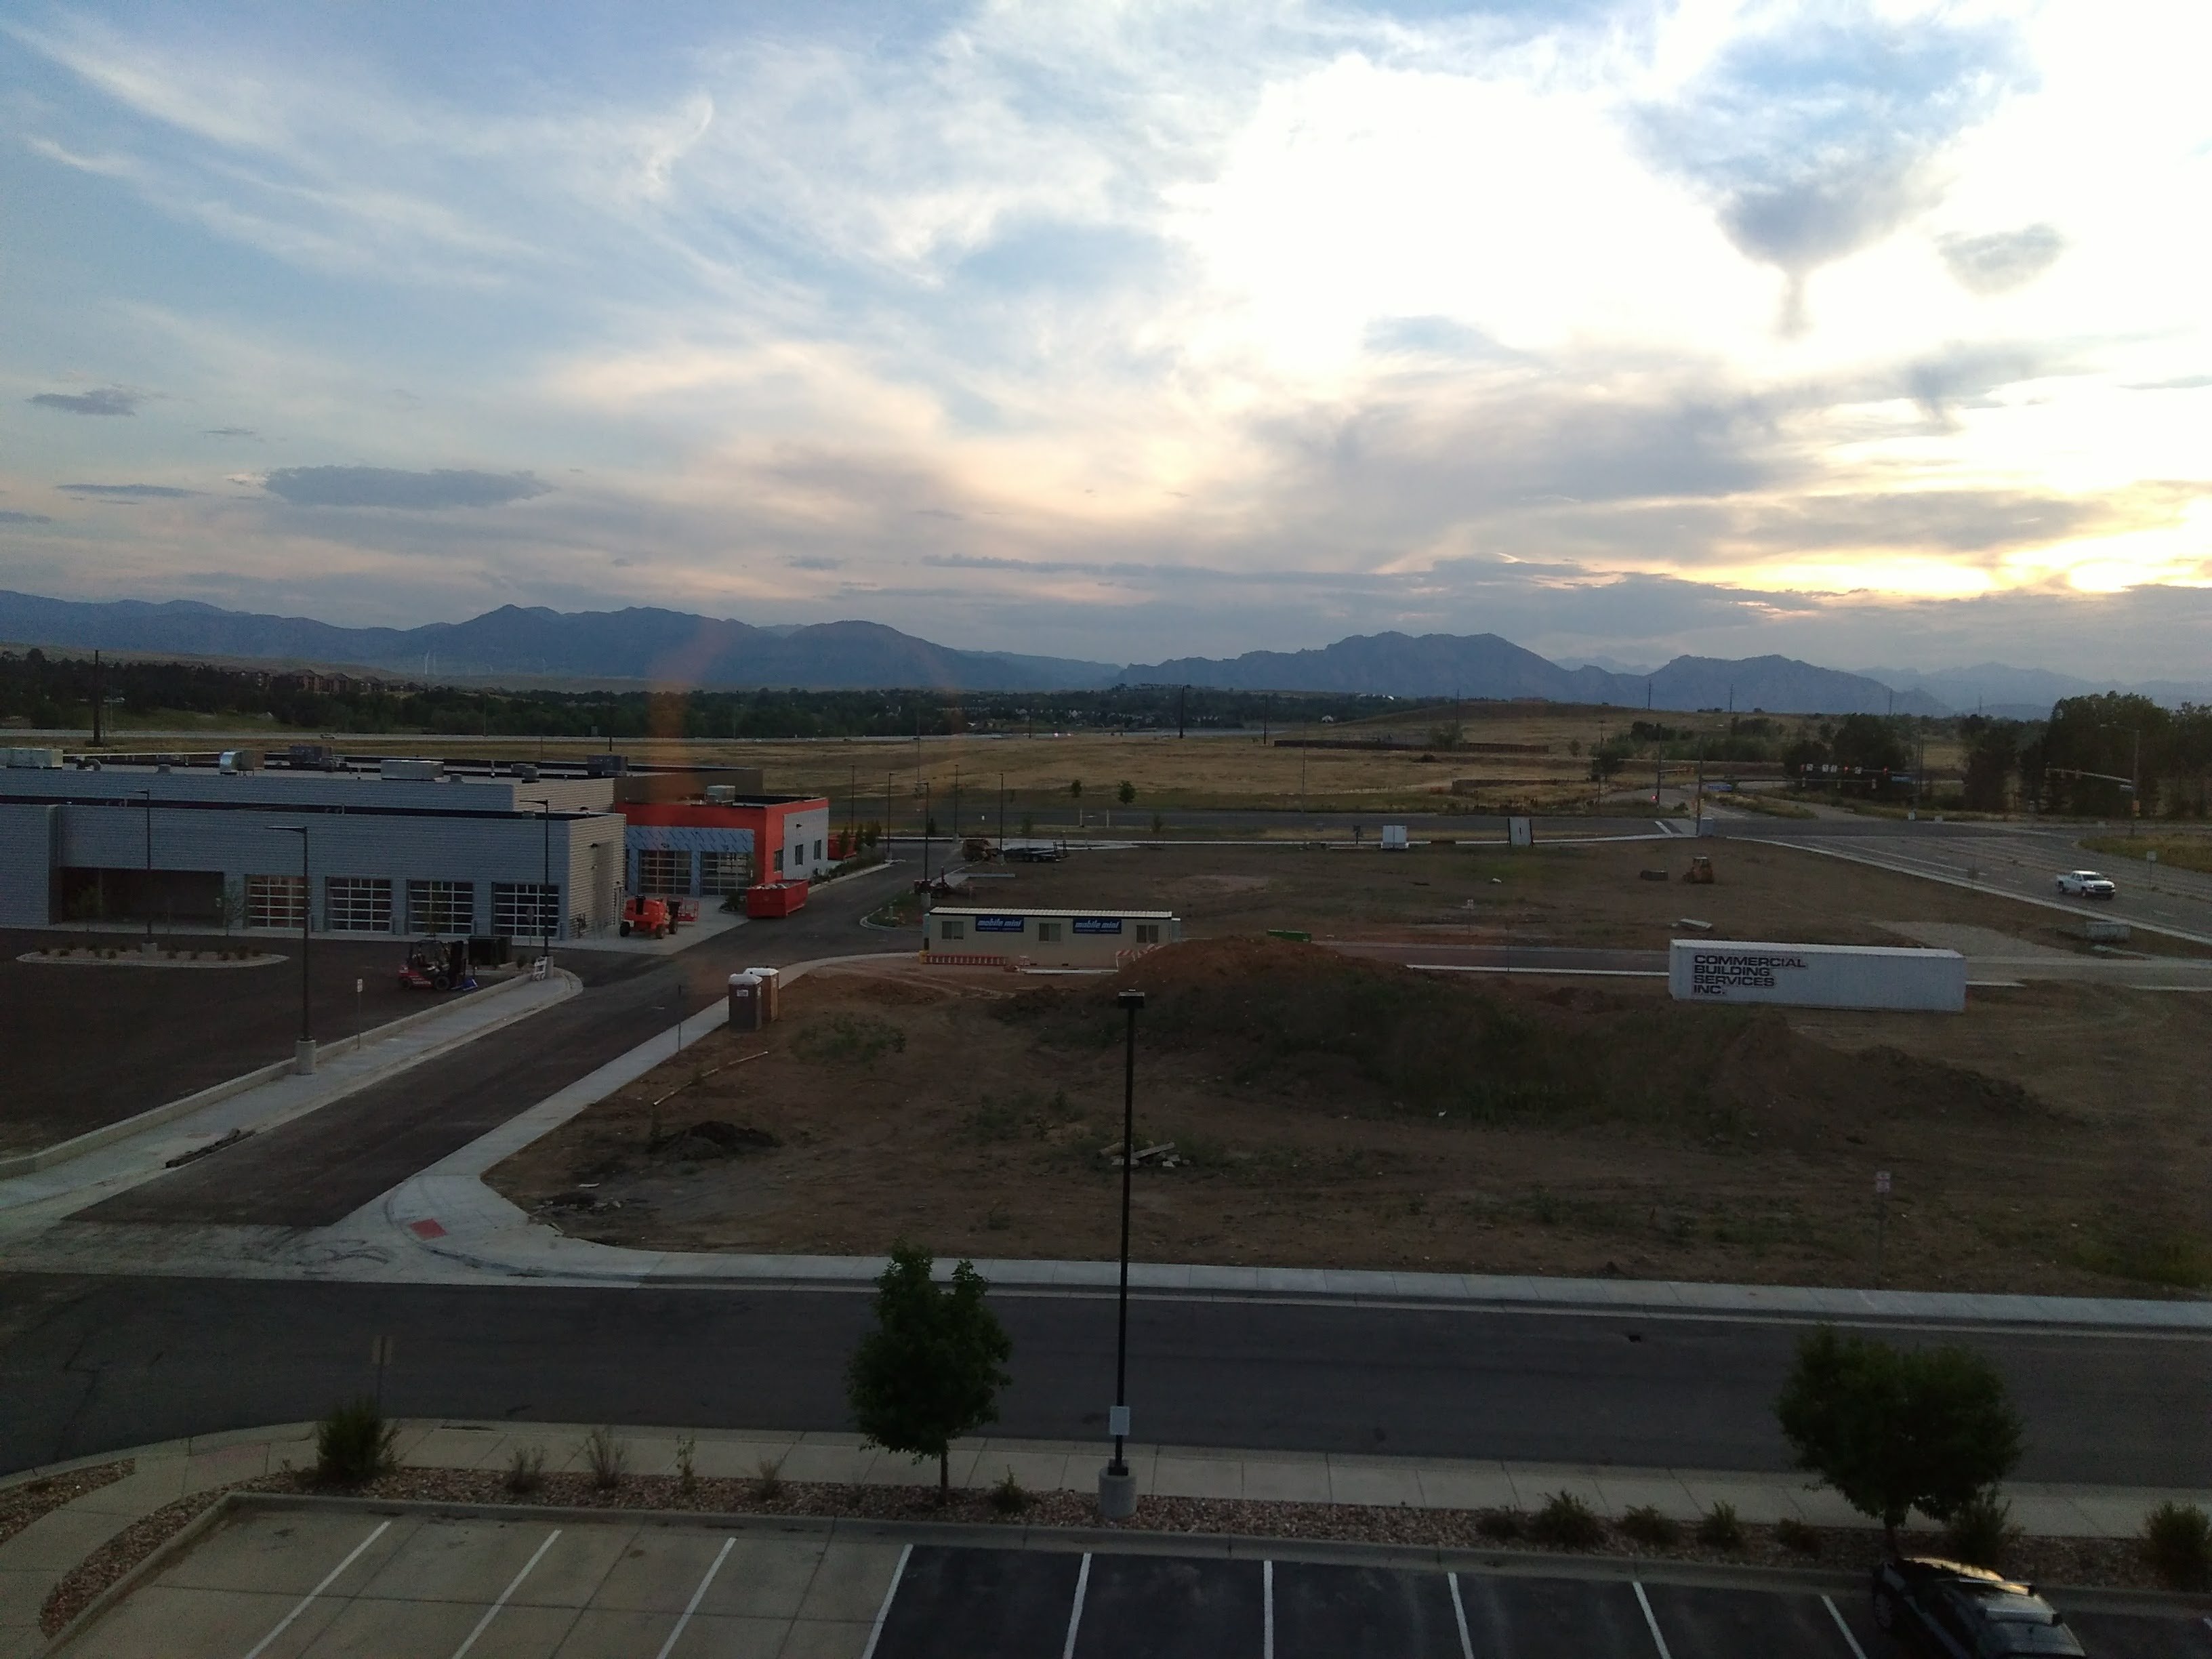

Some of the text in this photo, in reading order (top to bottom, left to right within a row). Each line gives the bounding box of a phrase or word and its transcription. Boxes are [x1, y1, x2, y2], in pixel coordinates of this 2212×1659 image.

[1075, 920, 1101, 928] mobile
[1694, 955, 1806, 968] COMMERCIAL
[1694, 964, 1770, 977] BUILDING
[1694, 975, 1775, 987] SERVICES
[1694, 985, 1725, 994] INC.
